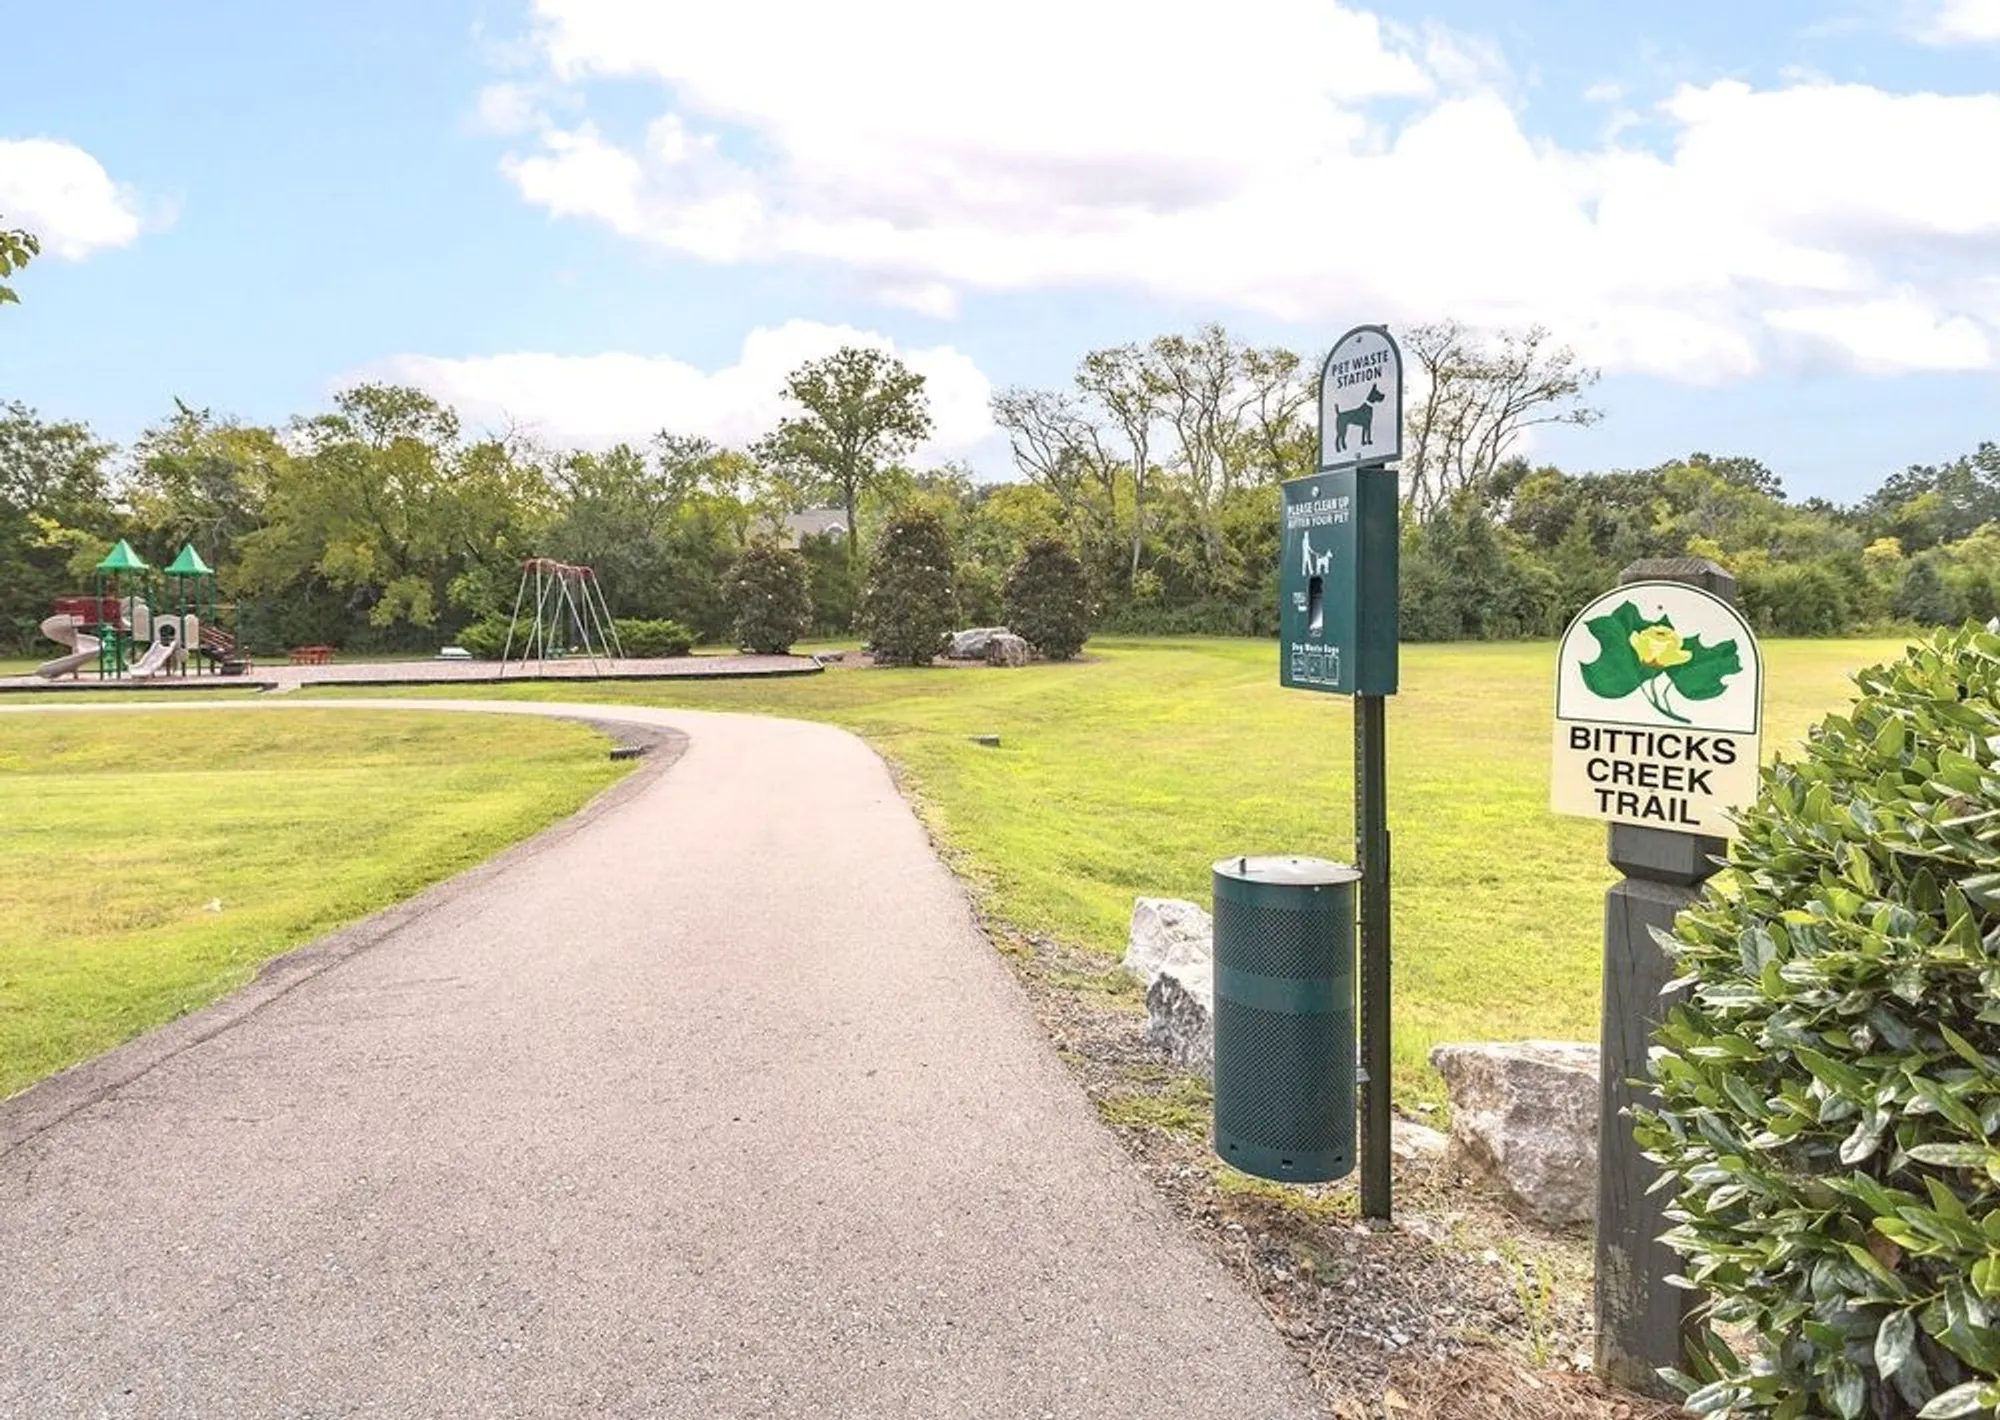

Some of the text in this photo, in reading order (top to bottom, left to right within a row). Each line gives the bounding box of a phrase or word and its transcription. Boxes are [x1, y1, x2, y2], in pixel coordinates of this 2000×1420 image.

[1332, 350, 1389, 377] PET WASTE
[1337, 366, 1382, 389] STATION
[1287, 501, 1313, 516] PLEASE
[1314, 498, 1337, 512] CLEAN
[1312, 515, 1333, 527] YOUR
[1334, 512, 1349, 524] PET
[1570, 726, 1736, 765] BITTICKS
[1587, 757, 1713, 795] CREEK
[1594, 788, 1700, 826] TRAIL
